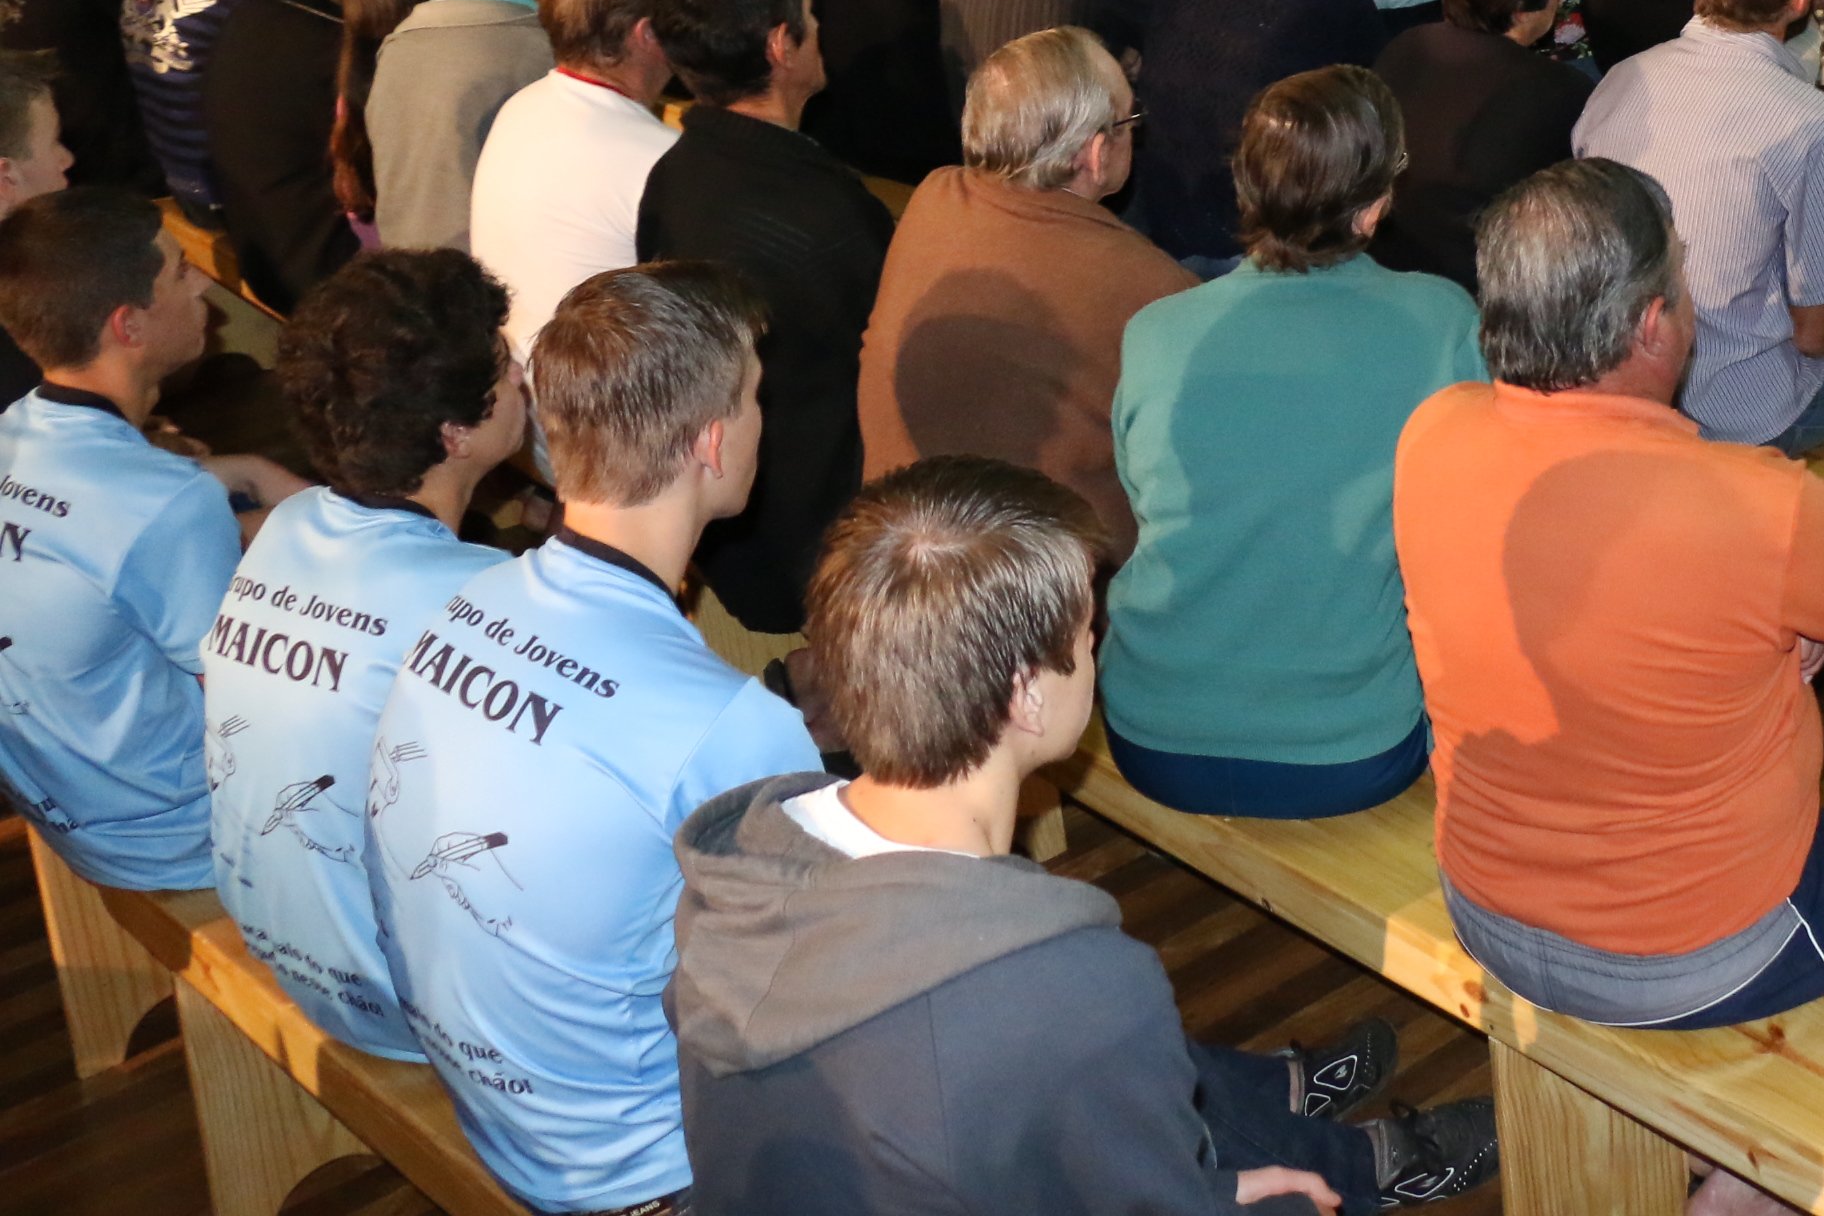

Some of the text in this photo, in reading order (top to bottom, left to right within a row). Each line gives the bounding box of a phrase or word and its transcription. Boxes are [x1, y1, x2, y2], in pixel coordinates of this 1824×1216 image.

[271, 586, 297, 611] de
[300, 595, 388, 636] Jovens
[208, 614, 348, 692] MAICON
[404, 630, 563, 746] MAICON
[484, 619, 514, 645] de
[514, 636, 619, 698] Jovens
[459, 1041, 503, 1065] que
